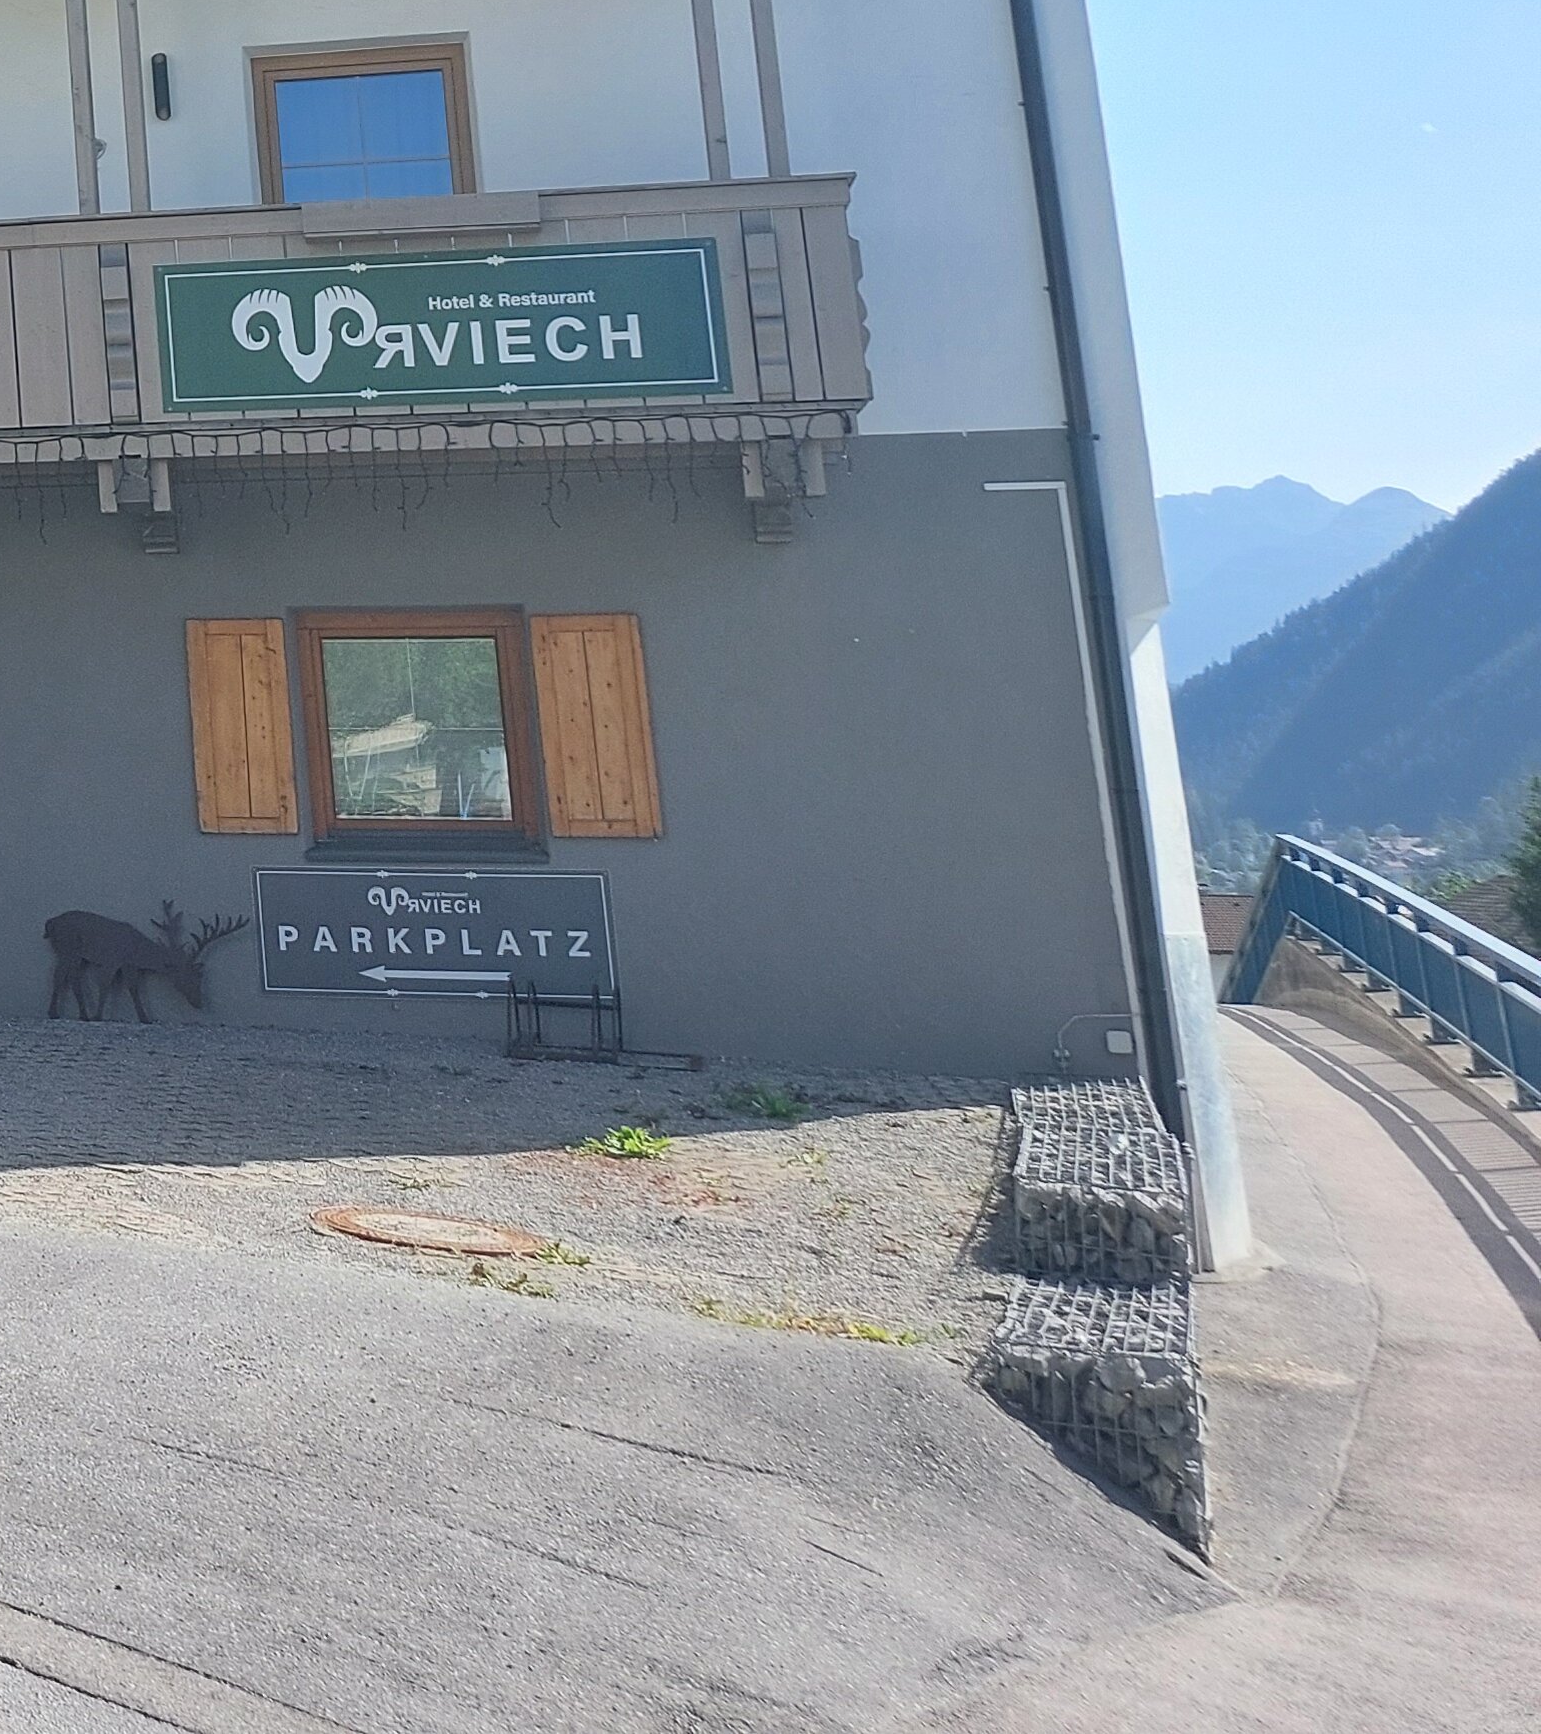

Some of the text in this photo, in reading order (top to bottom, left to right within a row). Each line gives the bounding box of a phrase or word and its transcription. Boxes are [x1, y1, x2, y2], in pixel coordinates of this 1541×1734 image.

[427, 288, 596, 311] Hotel & Restaurant
[278, 924, 592, 958] PARKPLATZ
